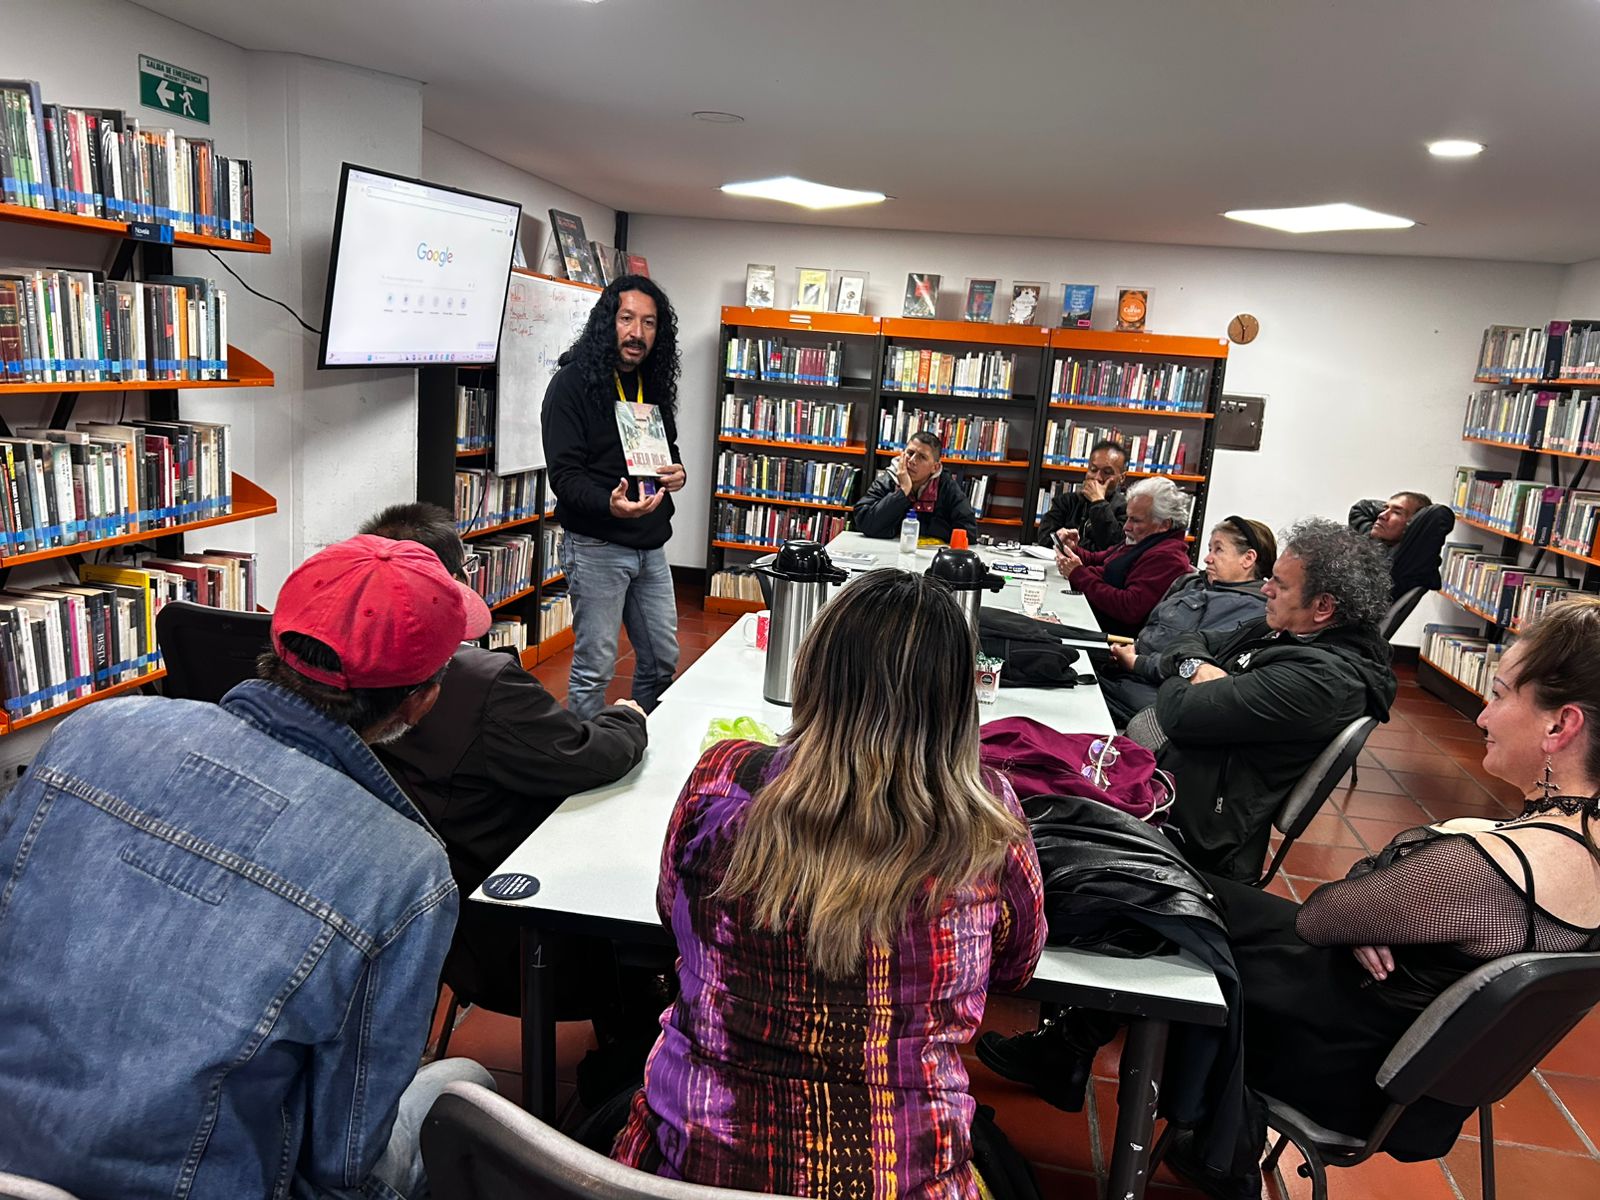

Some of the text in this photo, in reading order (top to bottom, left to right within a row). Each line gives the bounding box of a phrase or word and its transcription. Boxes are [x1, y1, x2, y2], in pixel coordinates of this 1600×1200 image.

[146, 60, 165, 72] SALIDA
[172, 68, 202, 85] EMERGENCIA
[416, 242, 454, 267] Google
[96, 633, 105, 666] BESTIA
